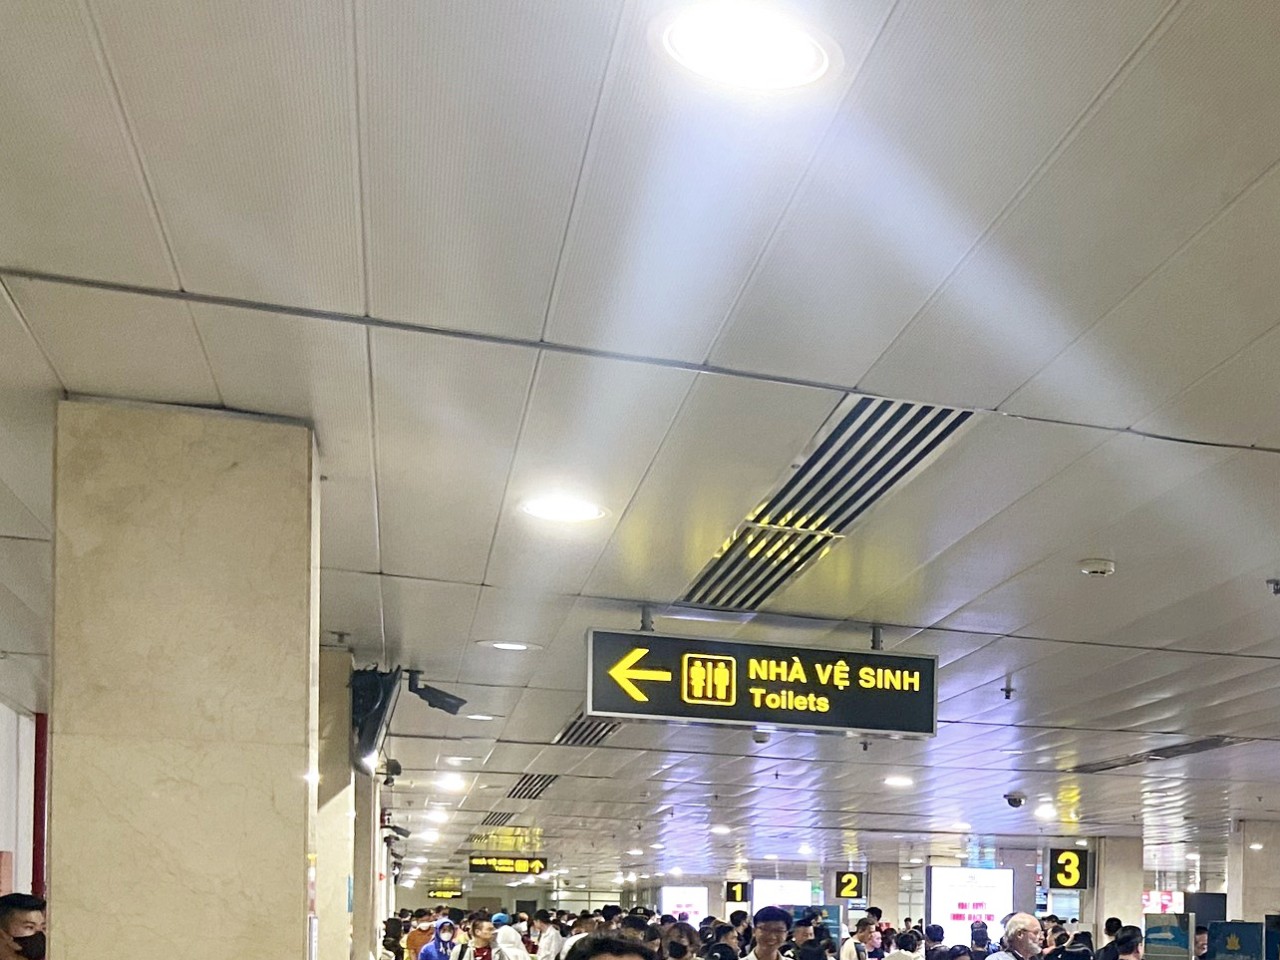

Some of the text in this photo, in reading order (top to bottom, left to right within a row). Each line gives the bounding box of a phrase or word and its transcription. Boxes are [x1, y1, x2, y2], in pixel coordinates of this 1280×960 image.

[748, 656, 921, 692] NHÀ VỆ SINH
[748, 687, 831, 713] Toilets
[1056, 851, 1080, 887] 3
[732, 883, 743, 902] 1
[840, 873, 858, 898] 2
